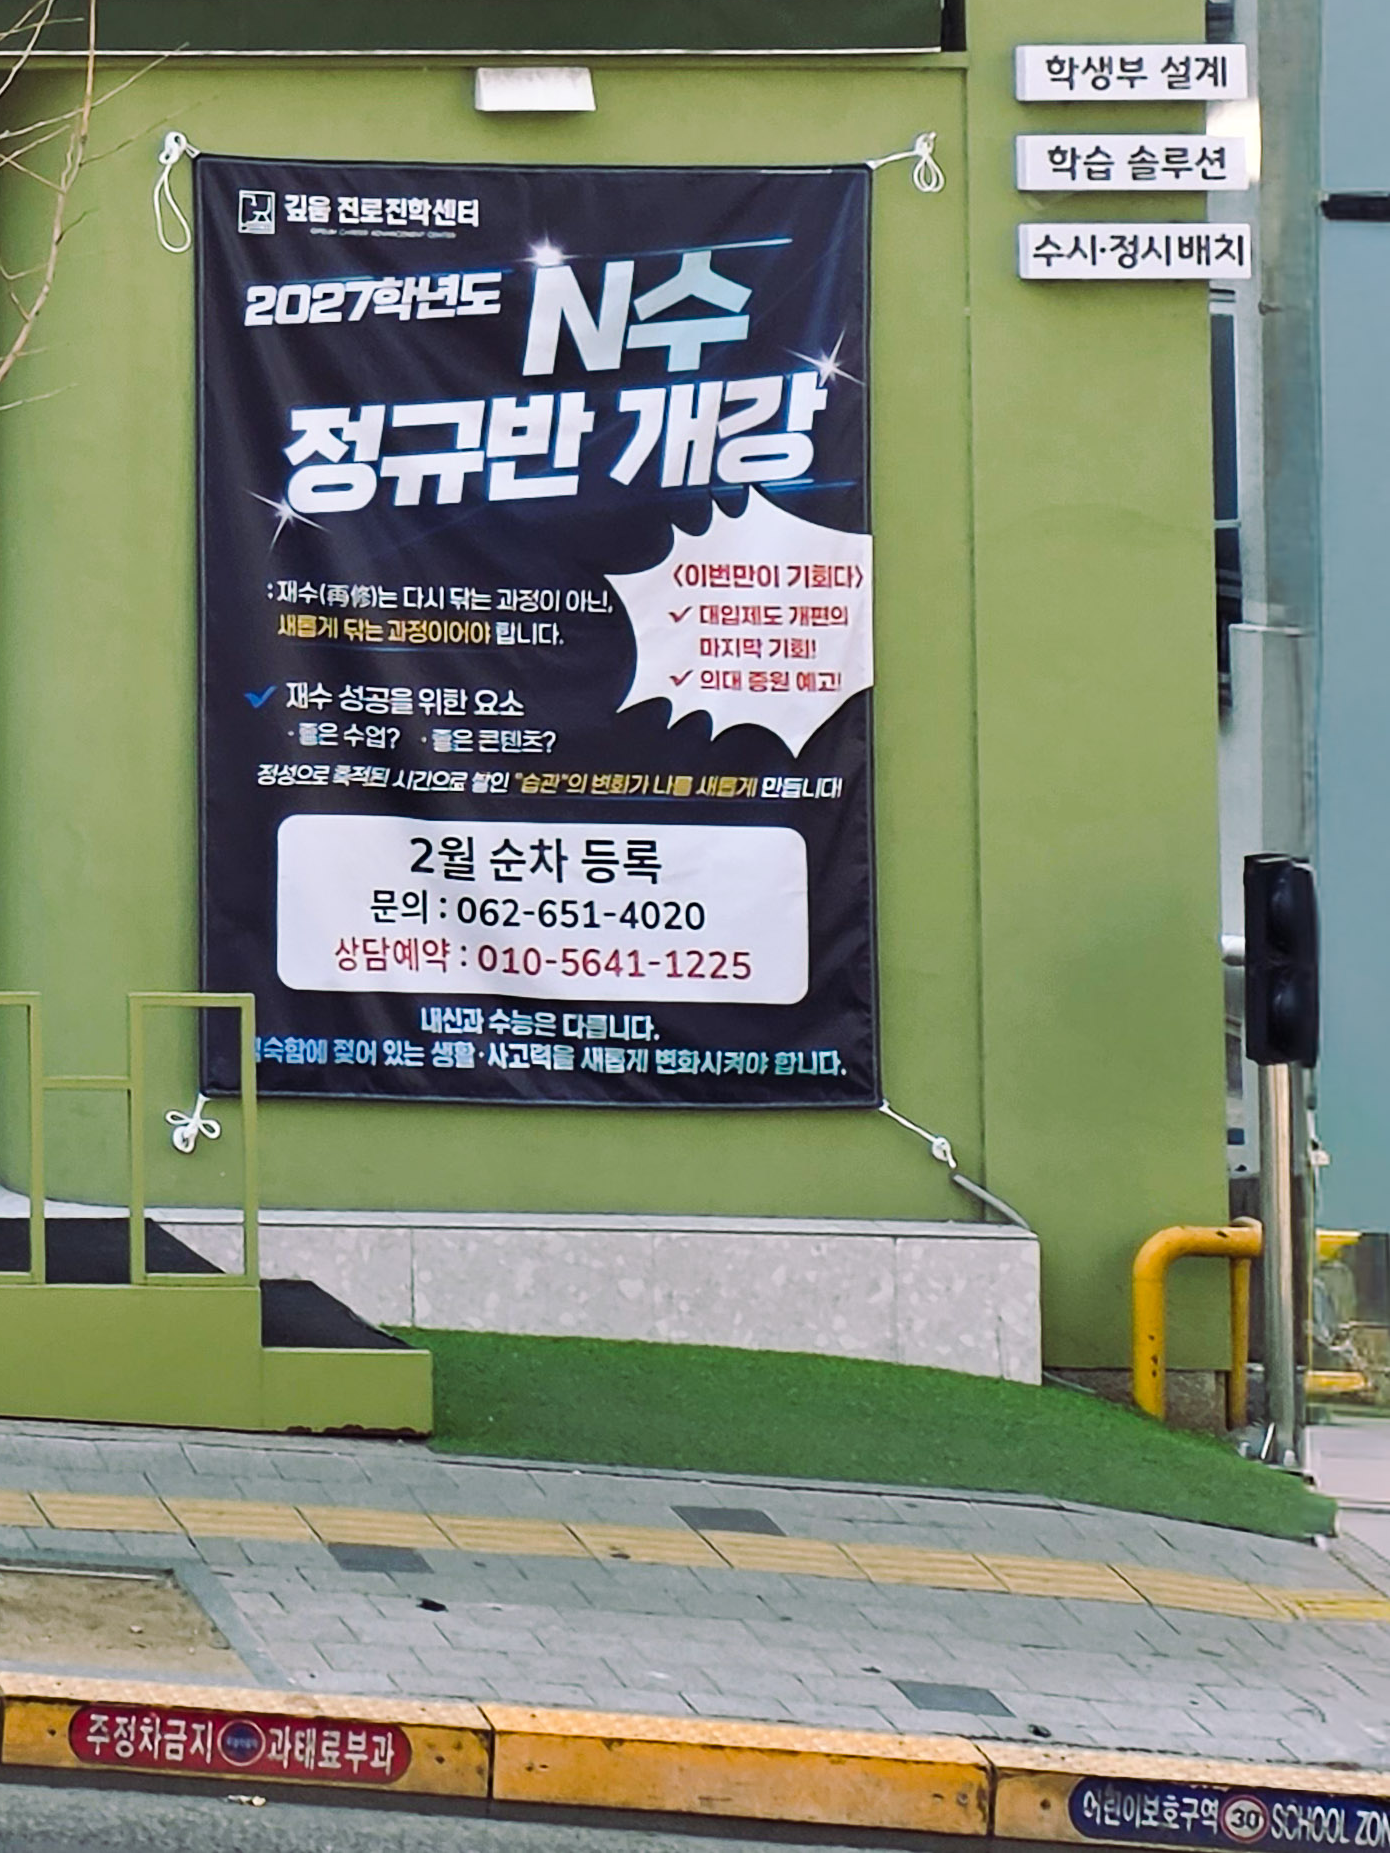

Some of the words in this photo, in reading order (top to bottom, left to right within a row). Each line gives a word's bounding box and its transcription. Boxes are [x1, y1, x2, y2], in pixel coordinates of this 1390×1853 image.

[1045, 54, 1148, 91] 학생부
[1159, 55, 1228, 91] 설계
[1047, 145, 1115, 182] 학습
[1127, 145, 1228, 181] 솔루션
[337, 196, 480, 228] 진로진학센터
[243, 270, 502, 327] 2027학년도
[522, 248, 753, 377] N수
[283, 391, 595, 514] 정규반
[609, 371, 828, 489] 개강
[403, 586, 445, 611] 다시
[496, 588, 560, 613] 과정이
[699, 604, 784, 626] 대입제도
[789, 605, 849, 627] 개편의
[387, 619, 492, 645] 과정이어야
[699, 637, 763, 659] 마지막
[768, 638, 817, 660] 기회!
[286, 681, 334, 711] 재수
[338, 684, 414, 716] 성공을
[418, 688, 468, 716] 위한
[473, 689, 525, 717] 요소
[700, 669, 742, 691] 의대
[747, 670, 791, 693] 증원
[342, 725, 401, 750] 수업?
[256, 763, 331, 787] 정성으로
[393, 769, 468, 793] 시간으로
[590, 773, 650, 796] 변화가
[409, 835, 477, 882] 2월
[489, 837, 570, 884] 순차
[580, 839, 663, 885] 등록
[369, 888, 429, 925] 문의
[456, 897, 707, 932] 062-651-4020
[334, 936, 452, 973] 상담예약
[476, 943, 754, 981] 010-5641-1225
[420, 1006, 485, 1035] 내신과
[488, 1008, 557, 1037] 수능은
[383, 1040, 425, 1067] 있는
[655, 1048, 769, 1076] 변화시켜야
[86, 1712, 214, 1764] 주정차금지
[266, 1725, 396, 1776] 과태료부과
[1230, 1807, 1262, 1830] 30
[1270, 1802, 1350, 1845] SCHOOL
